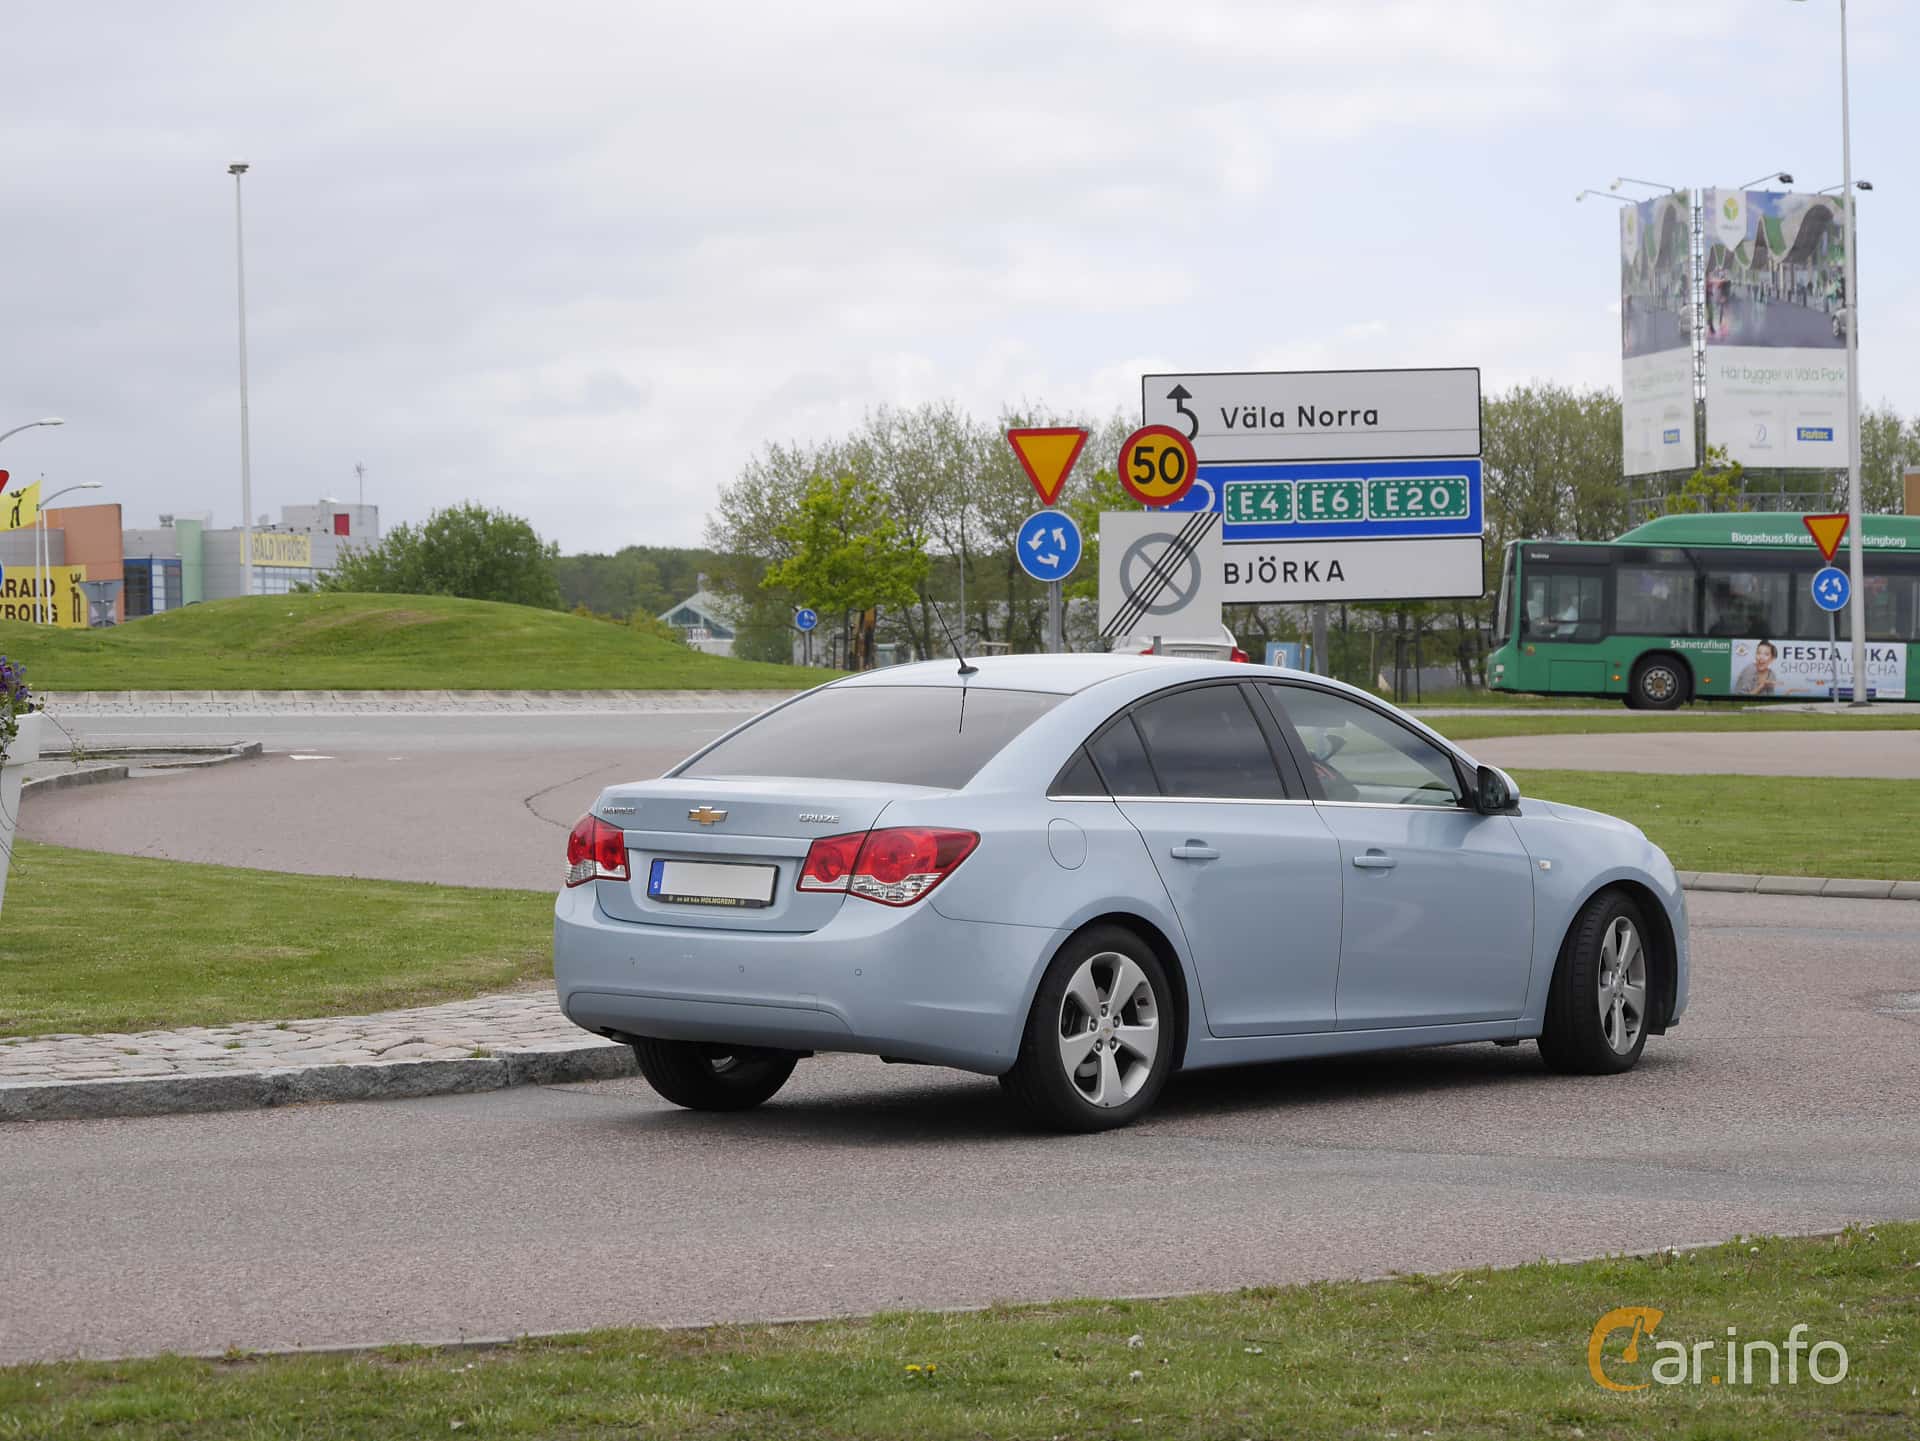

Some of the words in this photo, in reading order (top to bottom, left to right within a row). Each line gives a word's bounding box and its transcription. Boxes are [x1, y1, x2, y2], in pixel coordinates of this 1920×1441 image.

[1220, 405, 1285, 429] Väla
[1297, 404, 1379, 428] Norra
[1132, 445, 1185, 485] 50
[1240, 490, 1279, 515] E4
[1311, 488, 1350, 513] E6
[1385, 486, 1450, 512] E20
[1731, 532, 1784, 545] Biogasbuss
[1785, 533, 1798, 544] för
[1223, 555, 1345, 585] BJÖRKA
[799, 813, 840, 824] CRUZE
